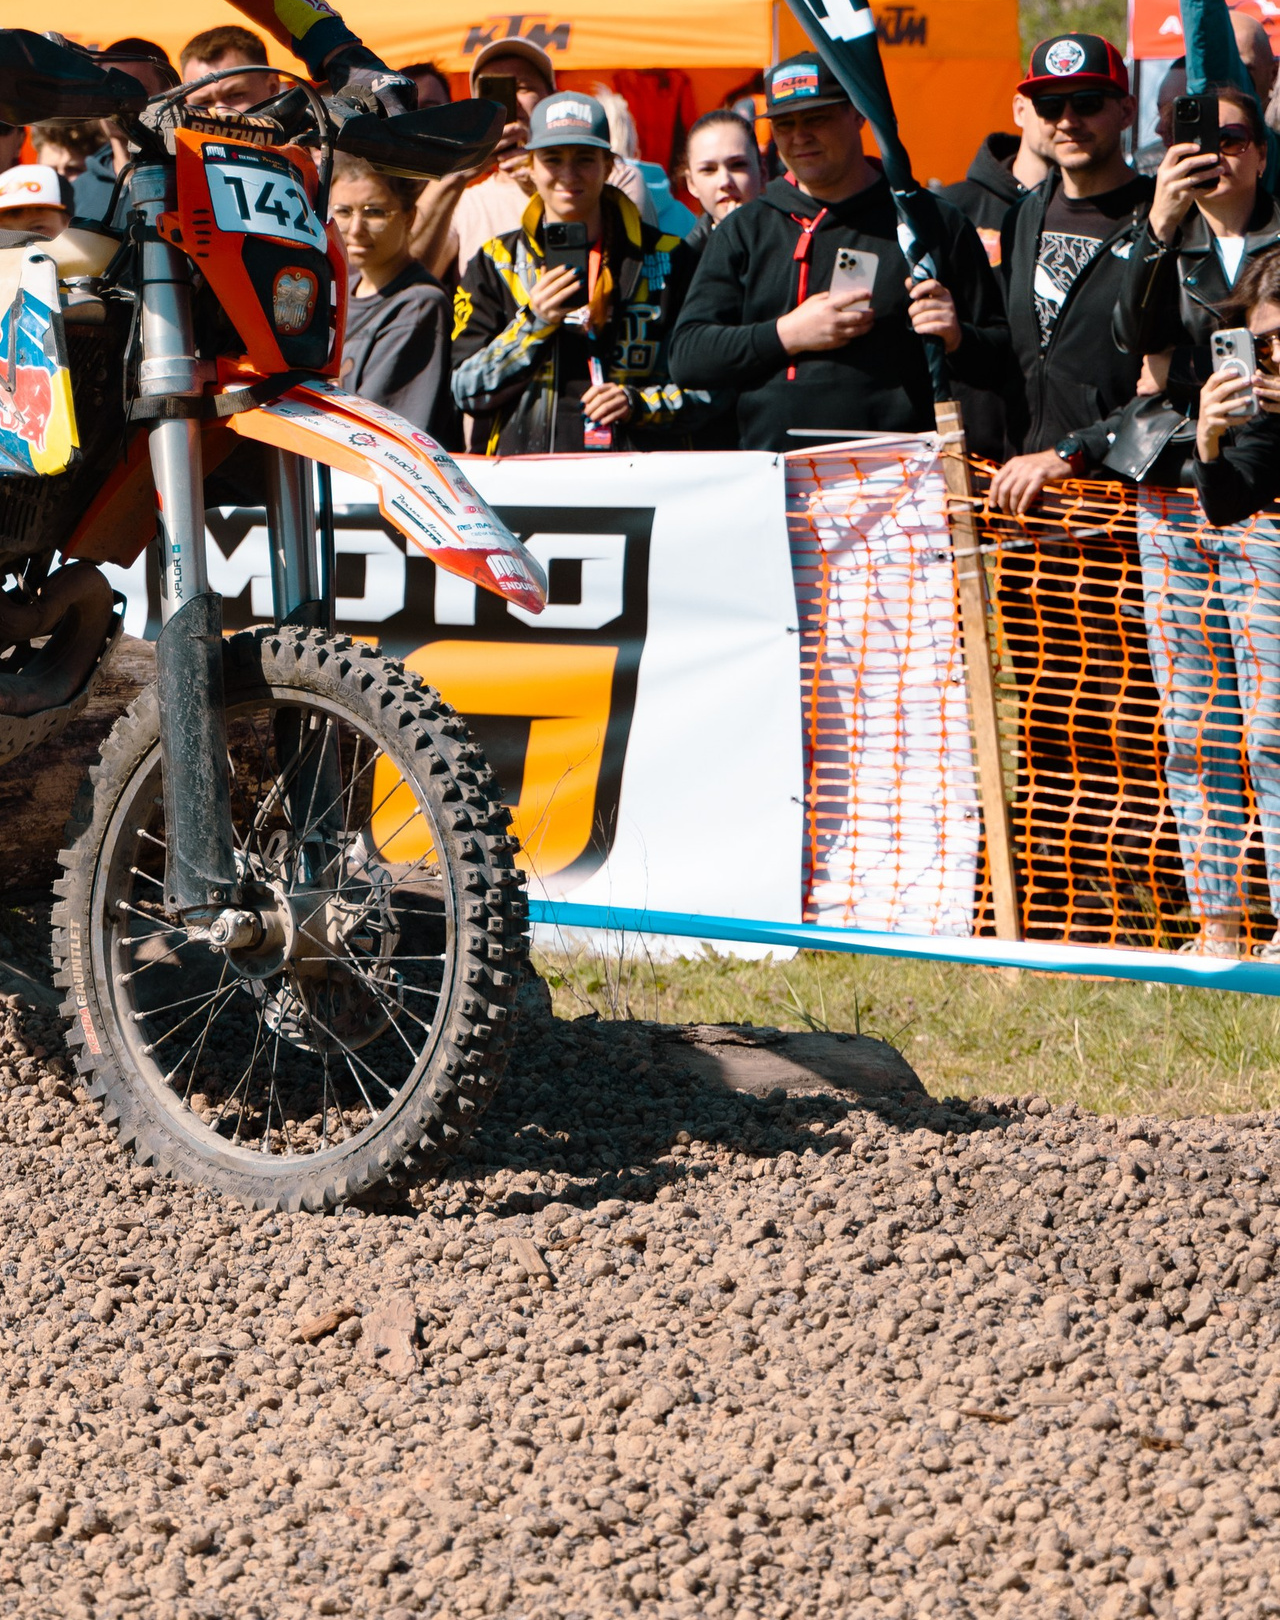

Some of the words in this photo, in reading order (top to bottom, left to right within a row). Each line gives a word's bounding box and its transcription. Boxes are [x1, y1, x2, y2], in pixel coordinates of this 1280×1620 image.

[462, 14, 571, 55] KTM
[875, 5, 928, 46] KTM
[223, 176, 318, 238] 142
[384, 451, 423, 480] VELOCITY
[173, 558, 183, 599] XPLOR
[498, 581, 540, 594] ENDURO
[70, 919, 88, 1007] GAUNTLET
[78, 1006, 102, 1055] KENDA
